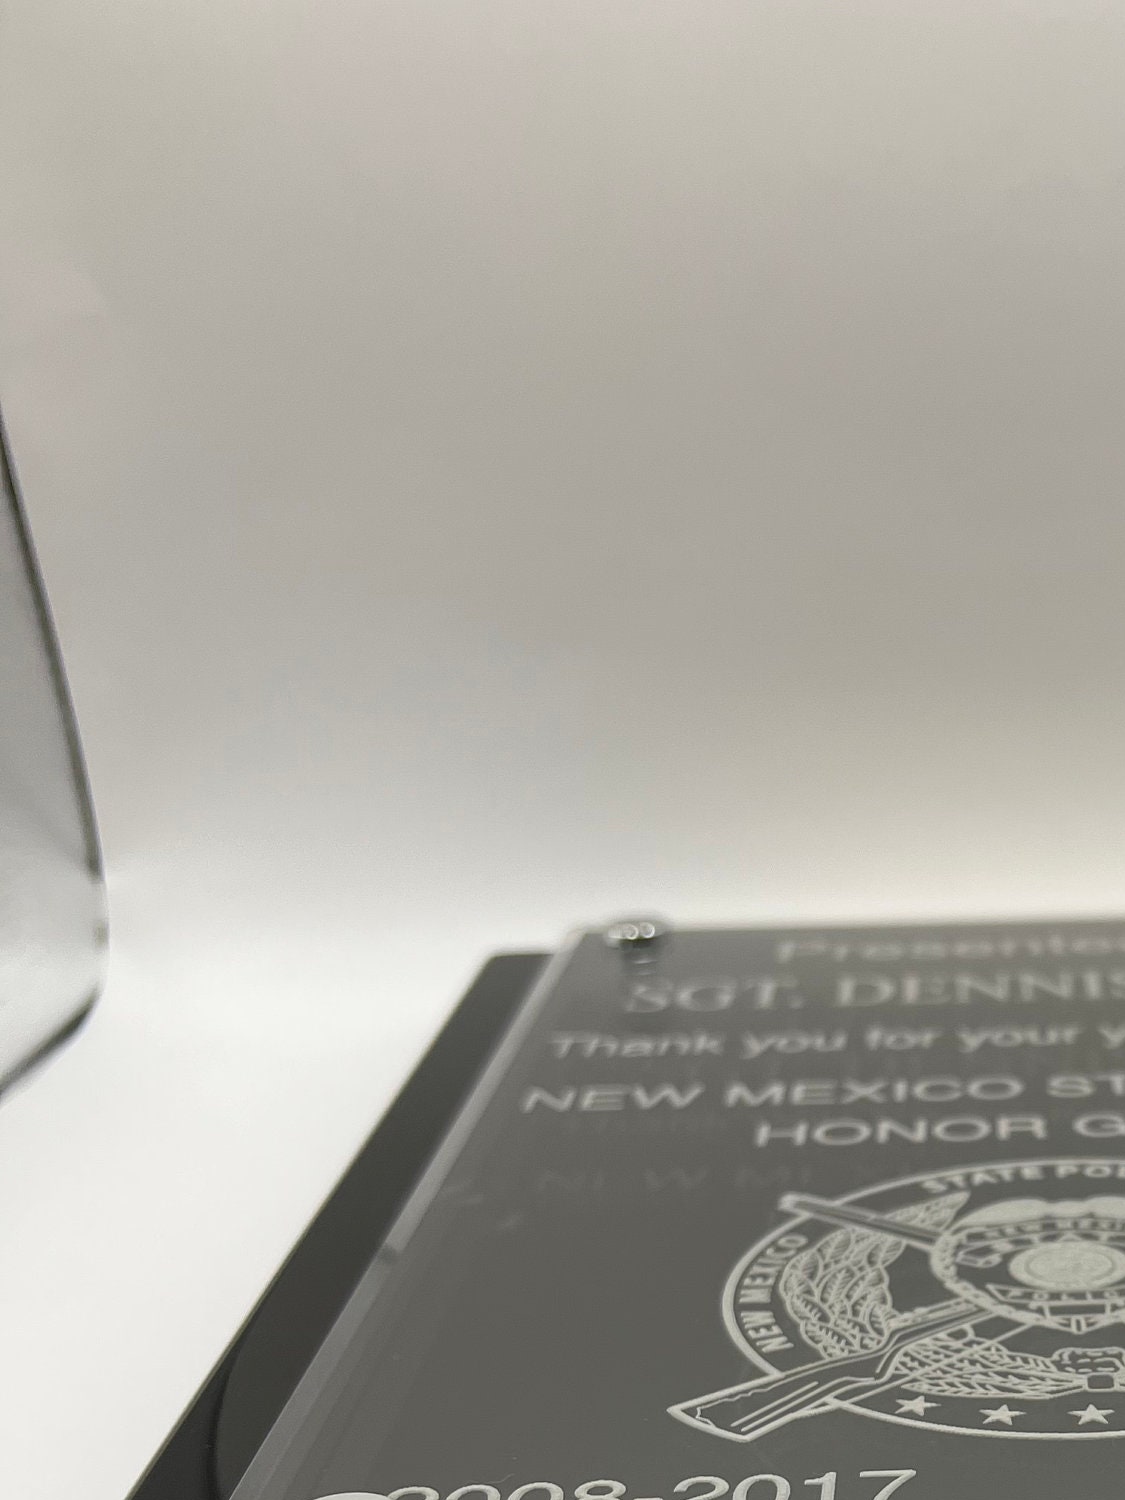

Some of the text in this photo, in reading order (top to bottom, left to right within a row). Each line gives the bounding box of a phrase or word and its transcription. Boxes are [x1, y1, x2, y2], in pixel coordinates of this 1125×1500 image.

[551, 1033, 724, 1058] Thank
[739, 1030, 846, 1059] you
[866, 1027, 938, 1051] for
[956, 1024, 1083, 1054] your
[521, 1085, 705, 1114] NEW
[724, 1075, 1025, 1108] MEXICO
[754, 1115, 1048, 1149] HONOR
[918, 1165, 1045, 1193] STATE
[739, 1233, 809, 1354] NEW MEXICO
